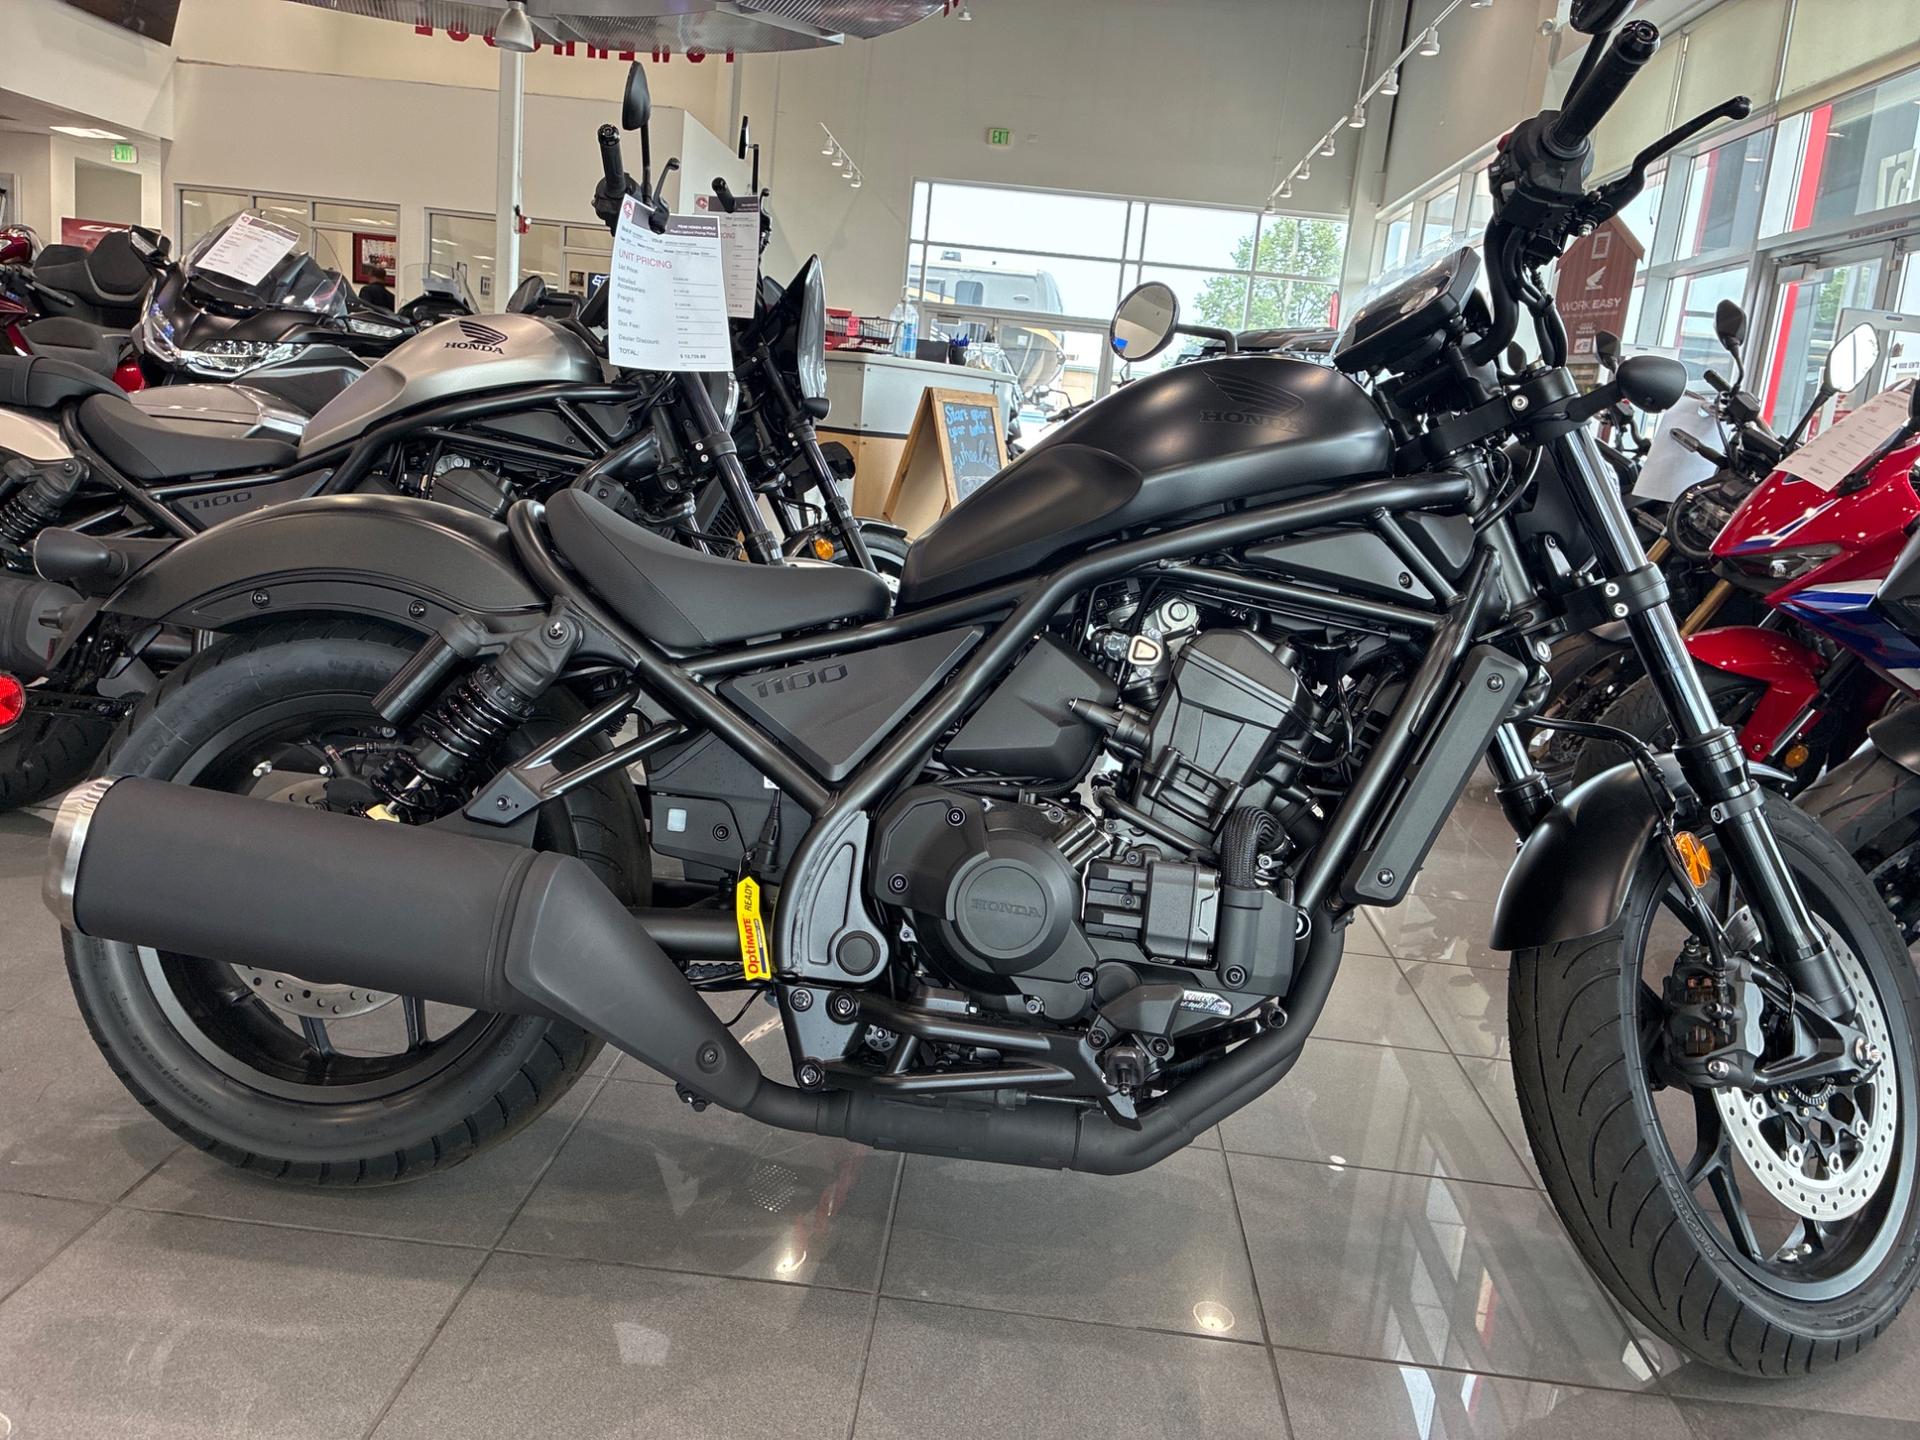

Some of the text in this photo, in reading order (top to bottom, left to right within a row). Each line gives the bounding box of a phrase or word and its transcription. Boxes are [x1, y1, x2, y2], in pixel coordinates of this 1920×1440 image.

[113, 143, 134, 161] EXIT
[619, 250, 672, 270] UNIT PRICING
[1561, 297, 1622, 313] WORK EASY
[444, 342, 505, 354] HONDA
[1199, 409, 1300, 433] HONDA
[189, 491, 252, 510] 1100
[751, 663, 848, 698] 1100
[744, 883, 752, 912] READY
[971, 898, 1042, 918] HONDA
